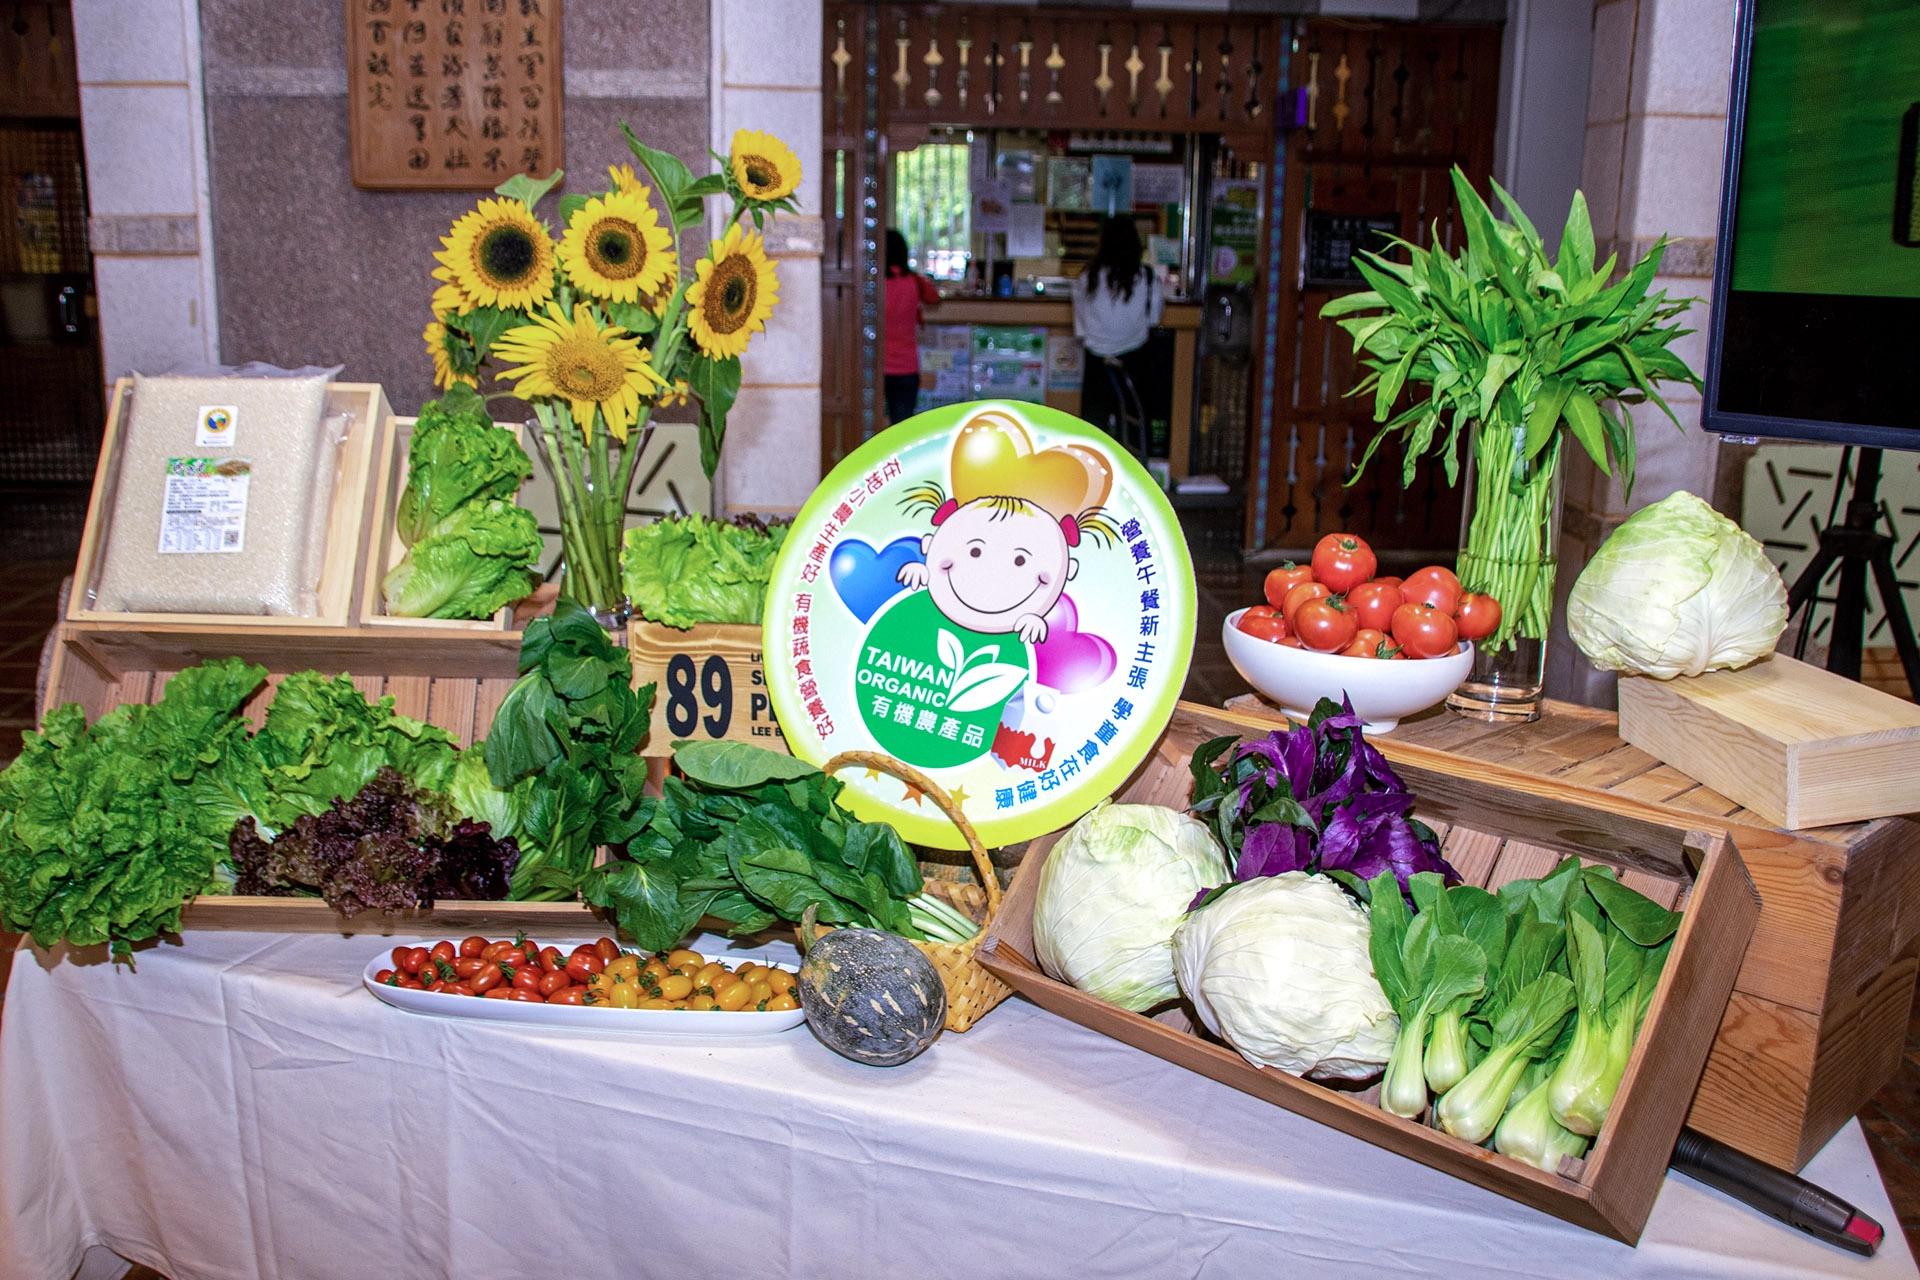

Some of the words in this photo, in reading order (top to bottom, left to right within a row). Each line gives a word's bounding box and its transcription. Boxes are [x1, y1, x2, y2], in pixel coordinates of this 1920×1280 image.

[800, 458, 902, 583] 在地小農生產好
[1119, 517, 1160, 690] 營養午餐新主張
[666, 653, 733, 739] 89
[791, 593, 835, 740] 有機蔬食營養好
[857, 668, 947, 708] ORGANIC
[867, 645, 955, 689] TAIWAN
[751, 726, 771, 736] LEE
[871, 694, 985, 749] 有機農產品
[995, 697, 1134, 810] 學童食在好健康
[1018, 757, 1047, 769] MILK
